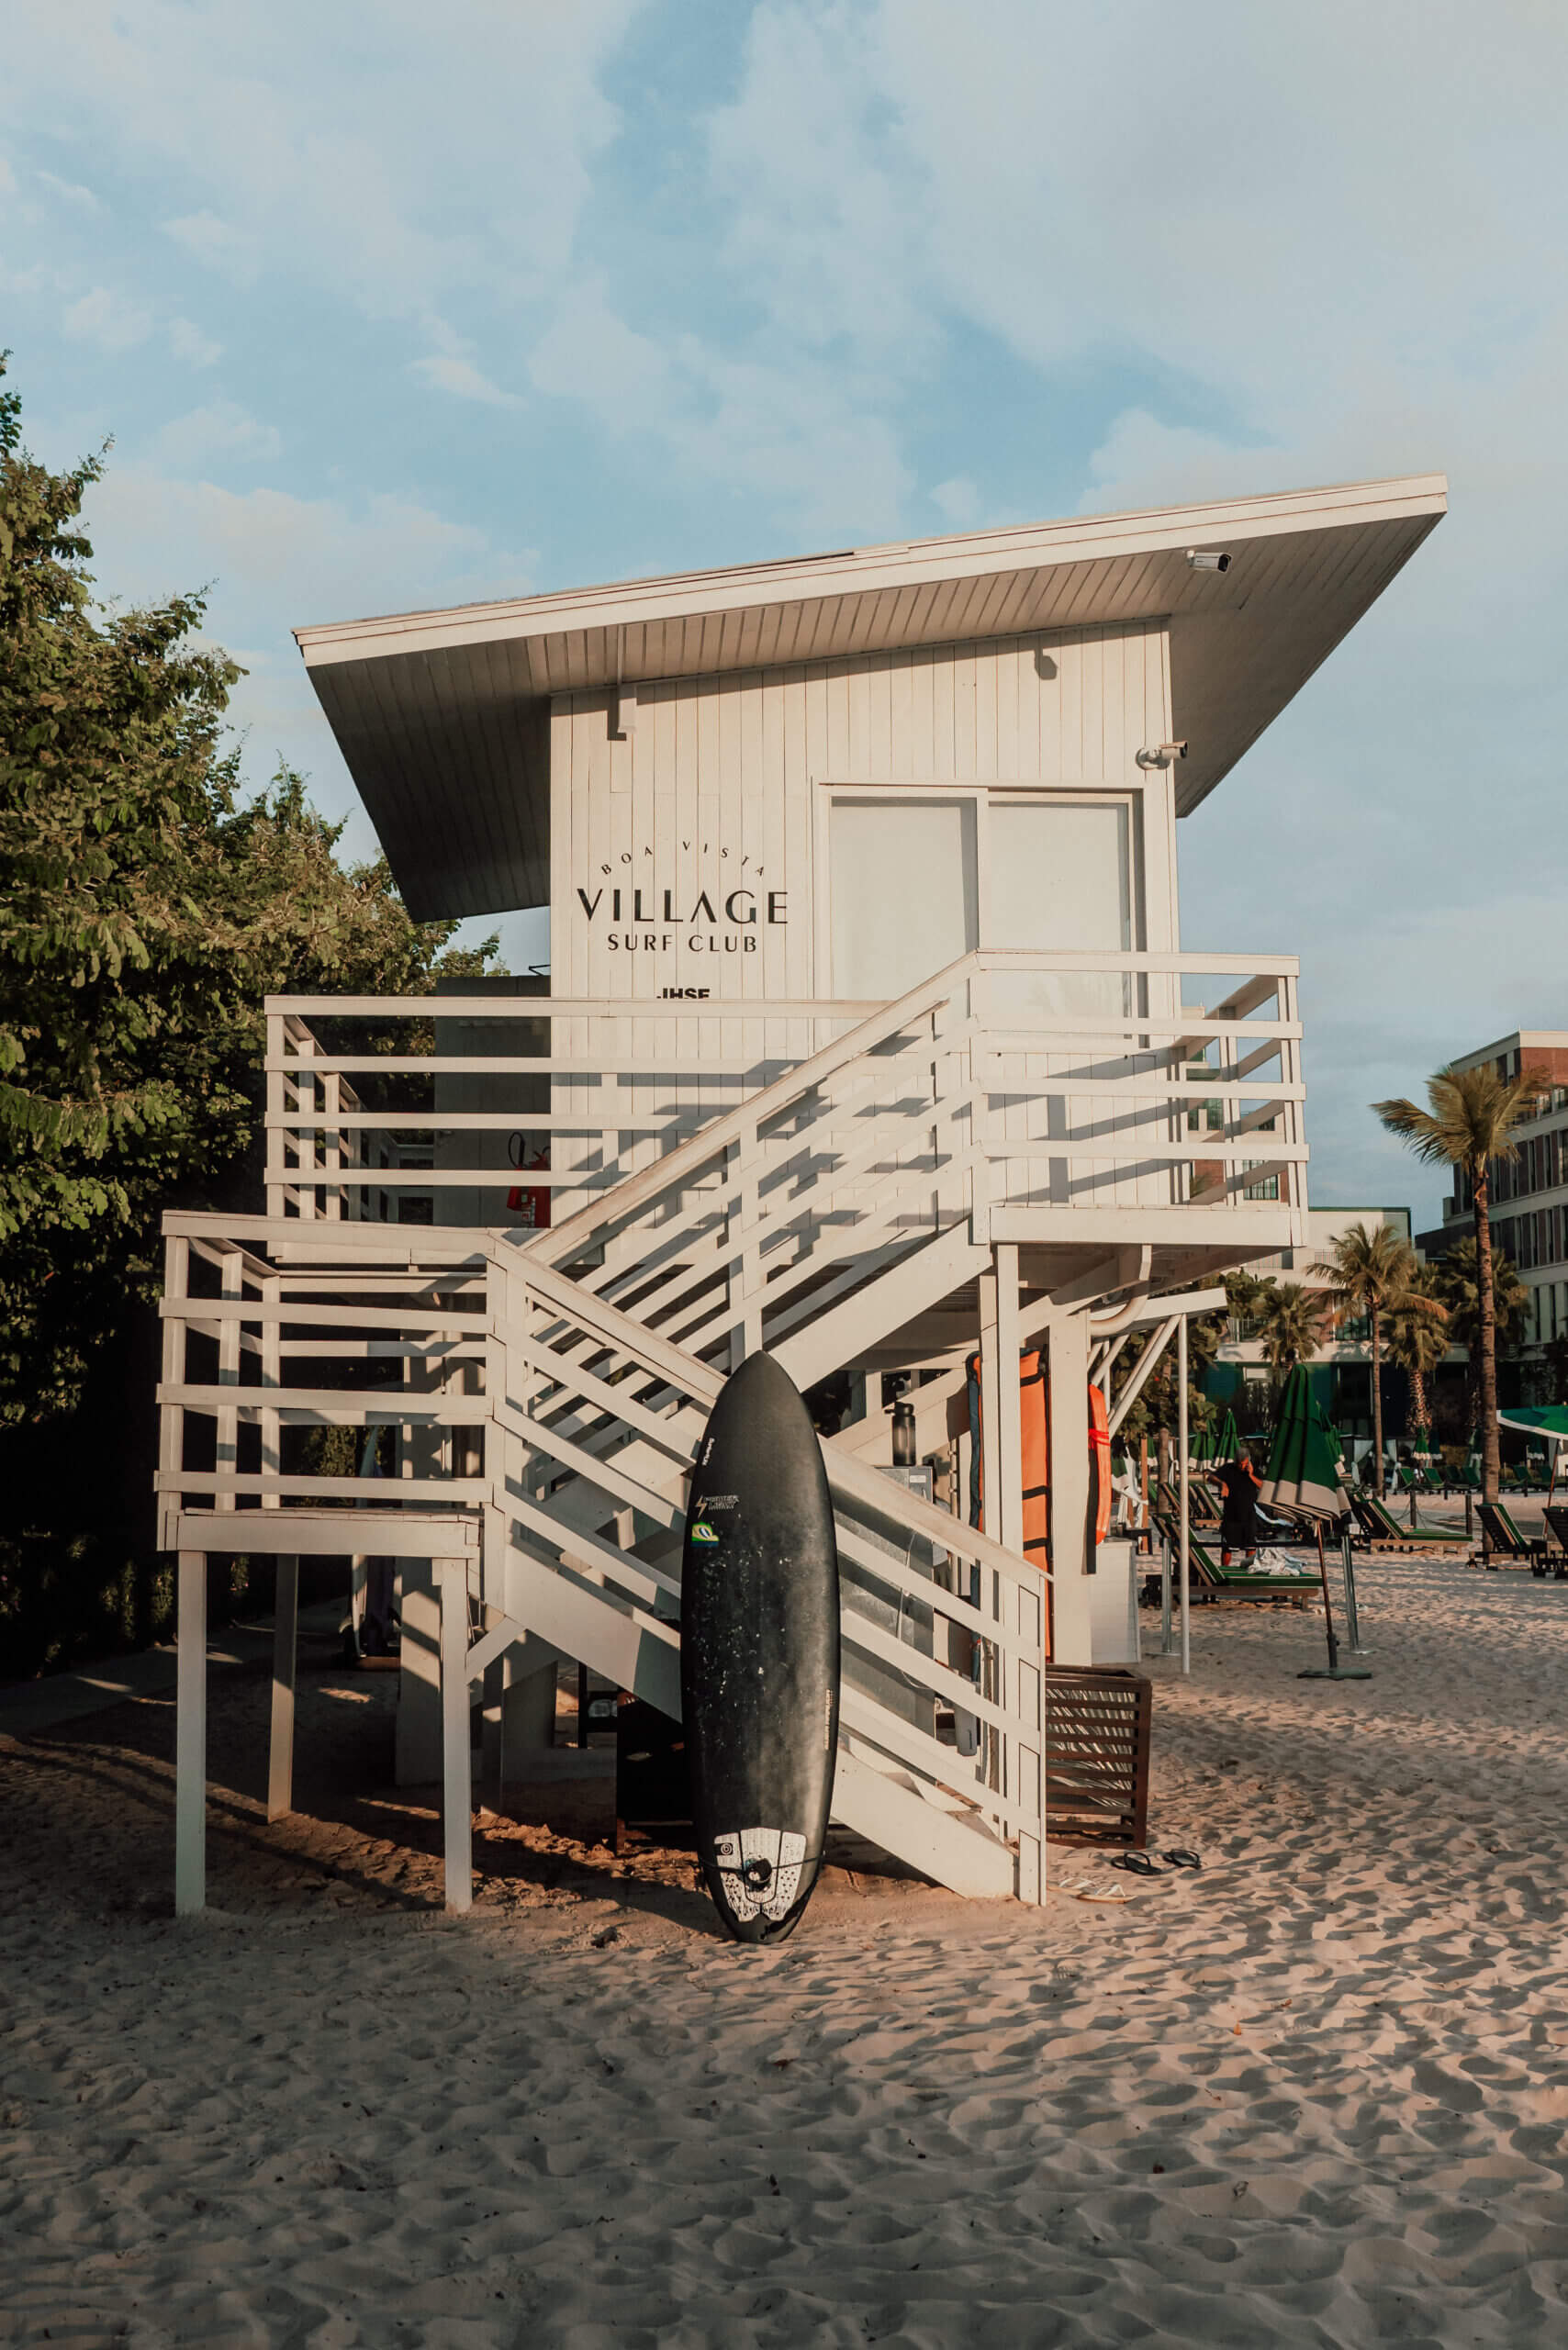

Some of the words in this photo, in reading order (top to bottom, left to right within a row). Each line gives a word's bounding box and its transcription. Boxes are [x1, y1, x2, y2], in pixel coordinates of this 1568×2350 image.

[601, 845, 653, 875] BOA
[682, 841, 765, 877] VISTA
[577, 888, 789, 924] VILLAGE
[608, 934, 674, 952] SURF
[689, 934, 757, 953] CLUB
